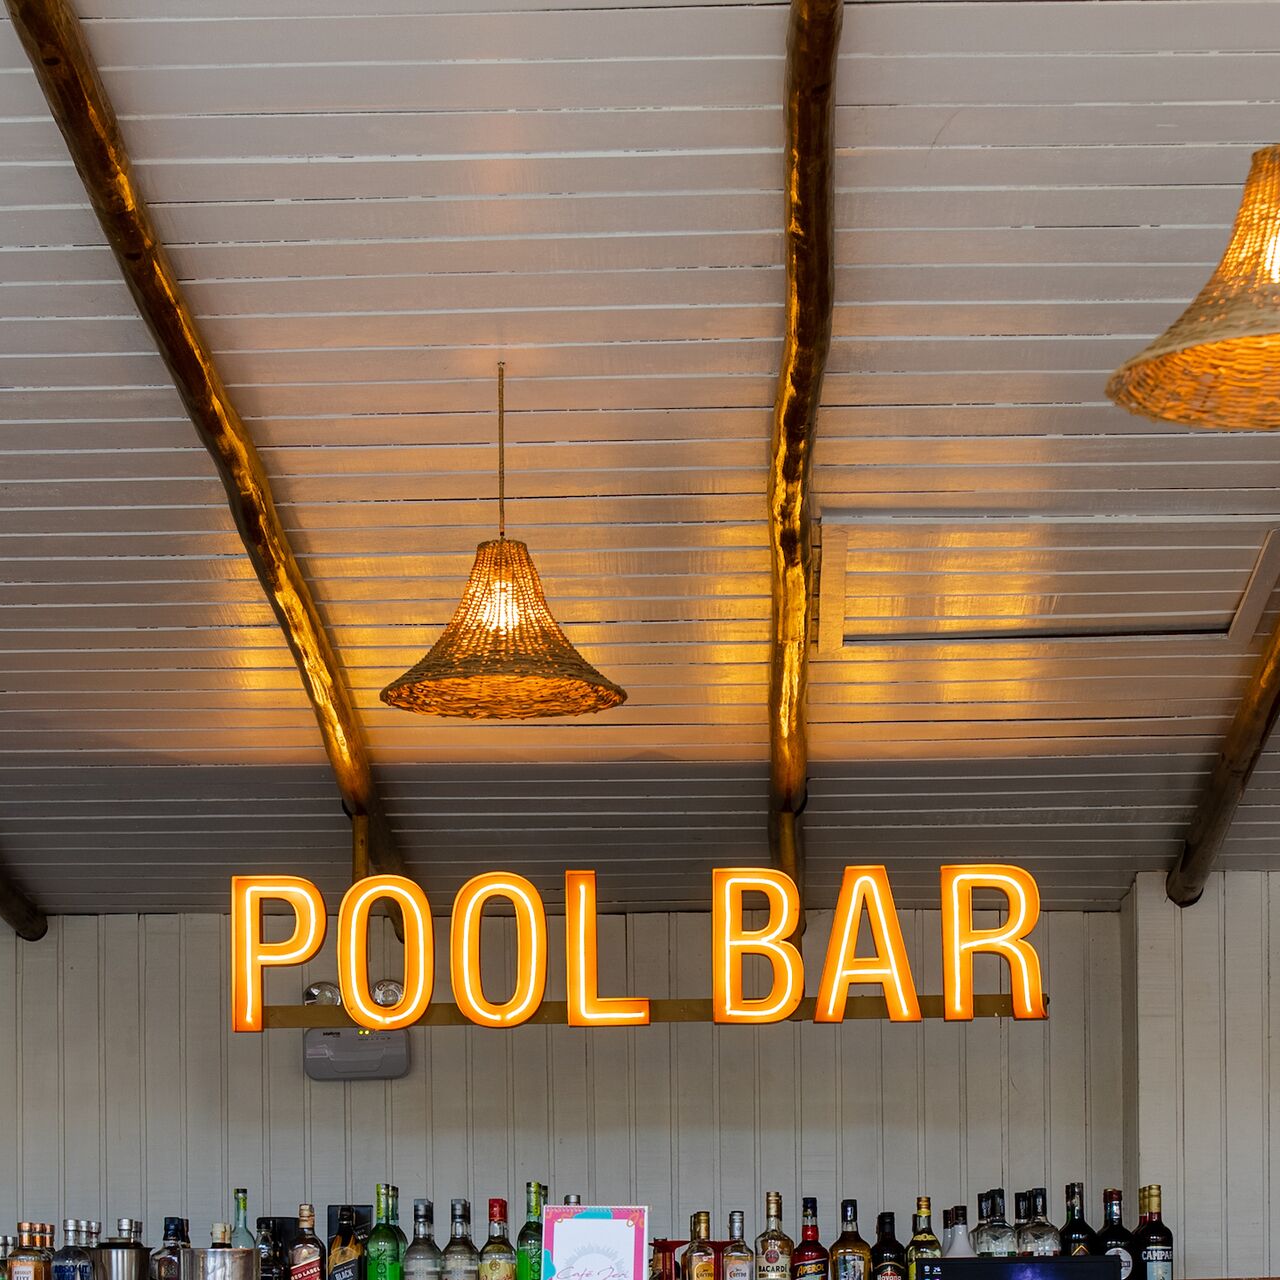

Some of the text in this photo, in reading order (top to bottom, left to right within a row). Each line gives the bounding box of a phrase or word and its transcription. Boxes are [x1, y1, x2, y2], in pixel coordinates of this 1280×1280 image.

[232, 865, 1047, 1032] POOL BAR
[1142, 1250, 1173, 1261] CAMPAR
[302, 1266, 320, 1277] LABEL
[797, 1264, 824, 1277] APEROL
